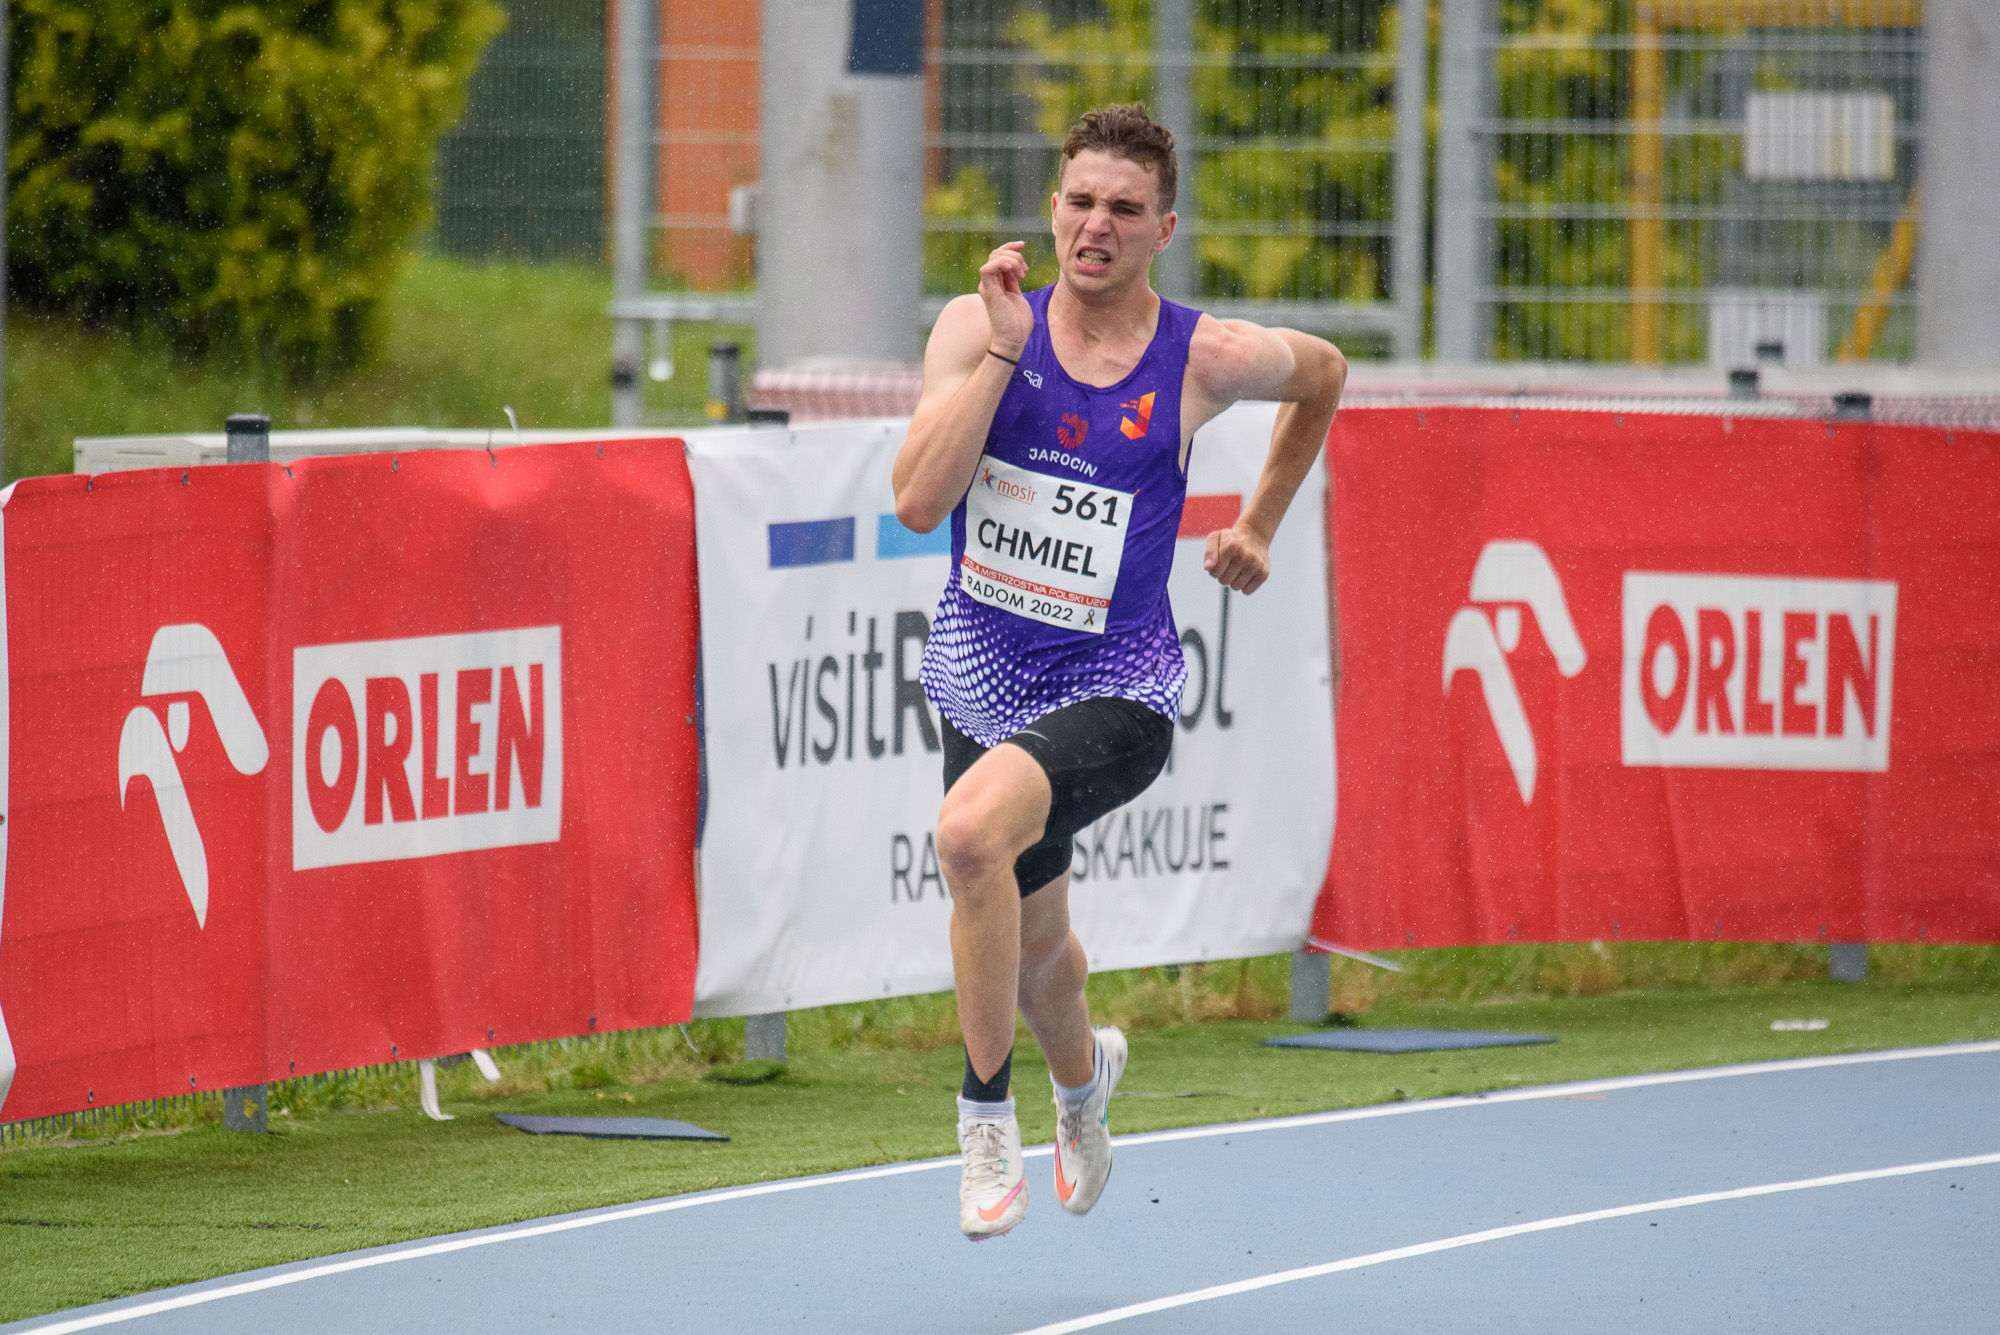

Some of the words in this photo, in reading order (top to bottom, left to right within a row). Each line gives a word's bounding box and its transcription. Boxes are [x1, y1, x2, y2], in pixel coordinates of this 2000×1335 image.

[1028, 448, 1098, 478] JAROCIN
[997, 480, 1038, 503] mosir
[1051, 484, 1118, 527] 561
[977, 518, 1098, 579] CHMIEL
[963, 557, 980, 574] PZLA
[980, 567, 1047, 595] MISTRZOSTWA
[1048, 588, 1084, 604] POLSKI
[1085, 596, 1107, 608] U20
[967, 575, 1024, 610] RADOM
[1029, 599, 1073, 622] 2022
[1639, 603, 1879, 739] ORLEN
[304, 663, 544, 834] ORLEN
[1071, 802, 1230, 883] SKAKUJE
